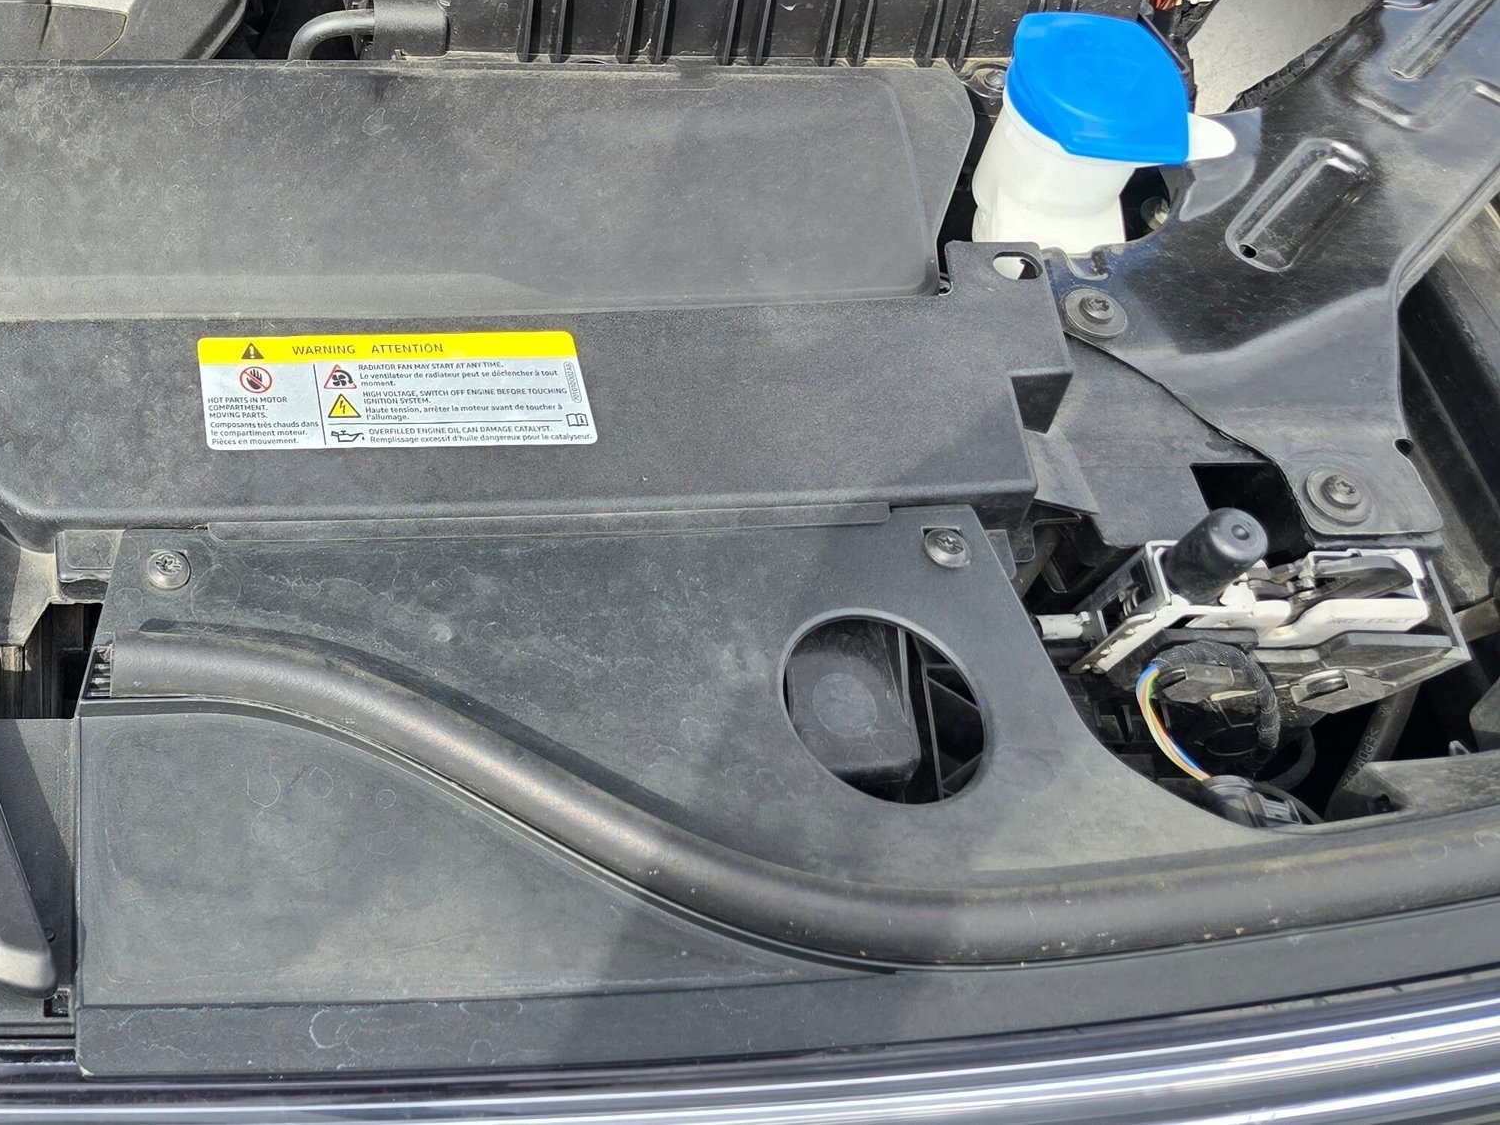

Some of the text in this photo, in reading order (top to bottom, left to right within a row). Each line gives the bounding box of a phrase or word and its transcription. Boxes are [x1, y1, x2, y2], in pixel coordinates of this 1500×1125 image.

[292, 343, 444, 355] WARNING ATTENTION
[551, 433, 593, 441] catalyseur.
